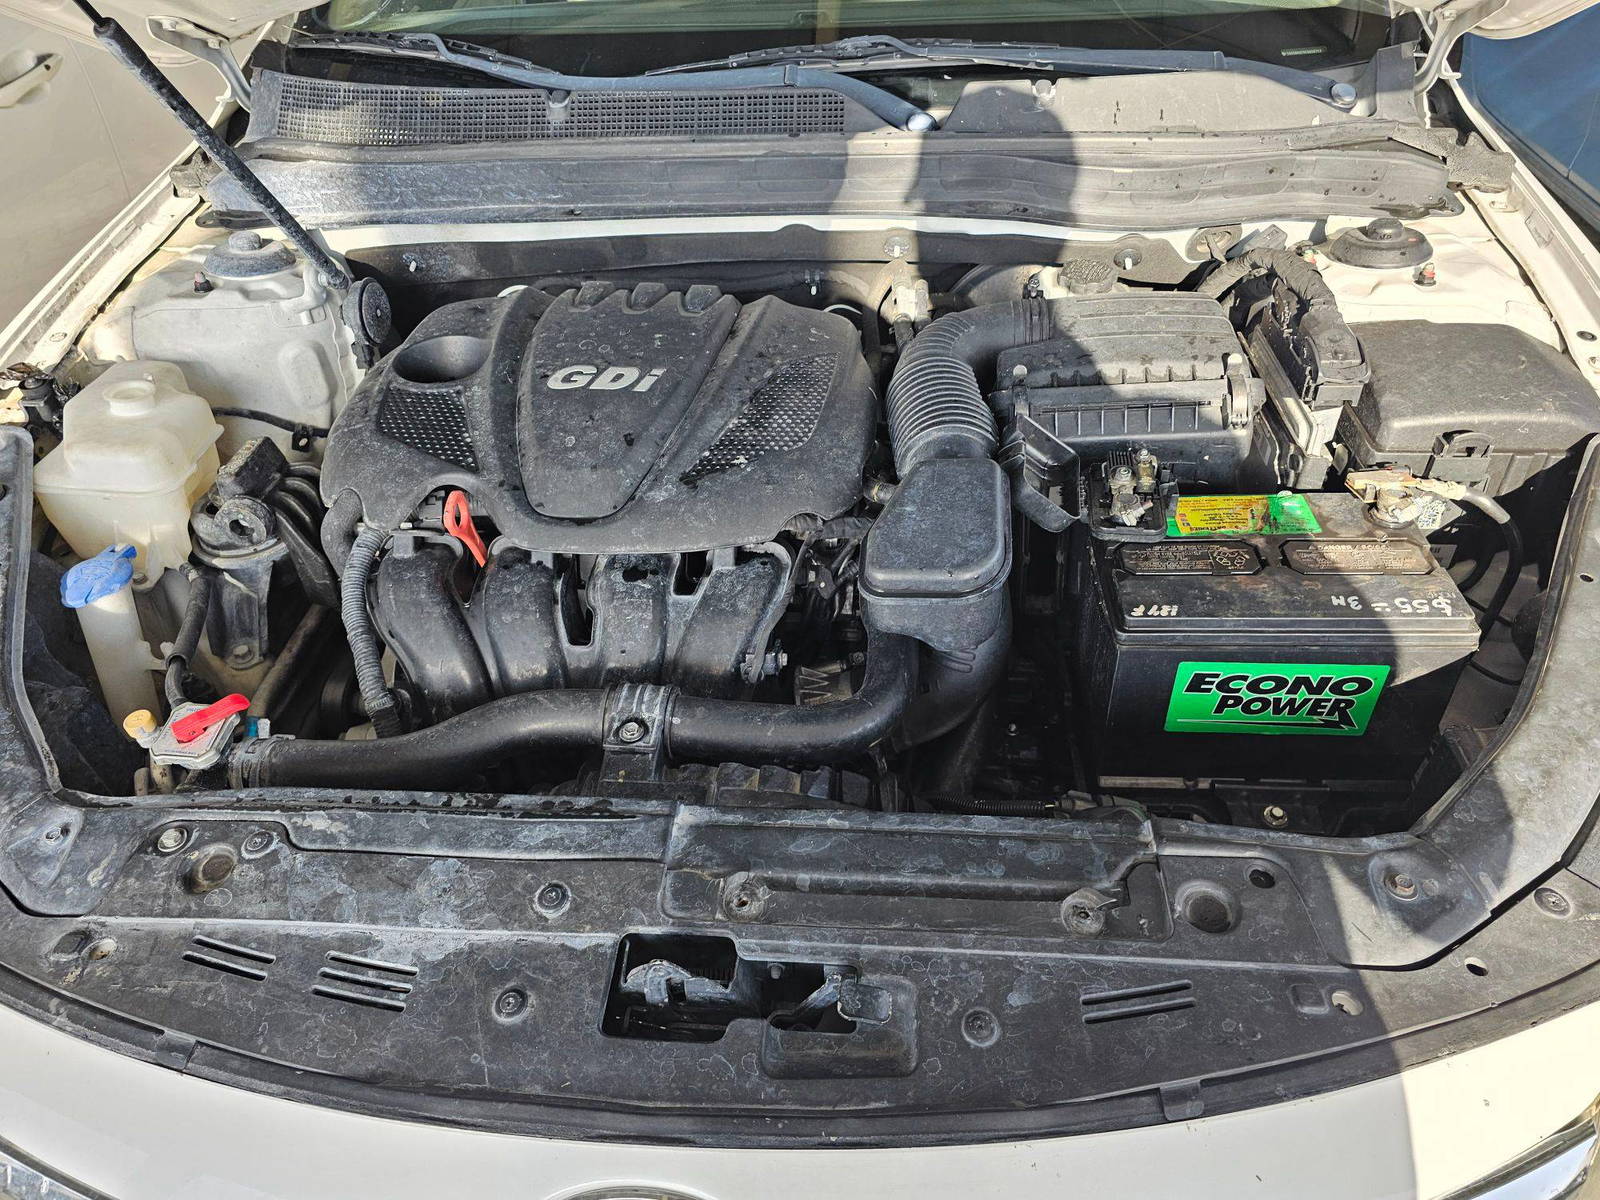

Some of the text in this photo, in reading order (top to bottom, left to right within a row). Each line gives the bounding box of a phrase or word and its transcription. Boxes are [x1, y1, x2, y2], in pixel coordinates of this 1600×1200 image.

[547, 365, 667, 392] GDi
[1183, 672, 1374, 697] ECONO
[1212, 695, 1358, 729] POWER
